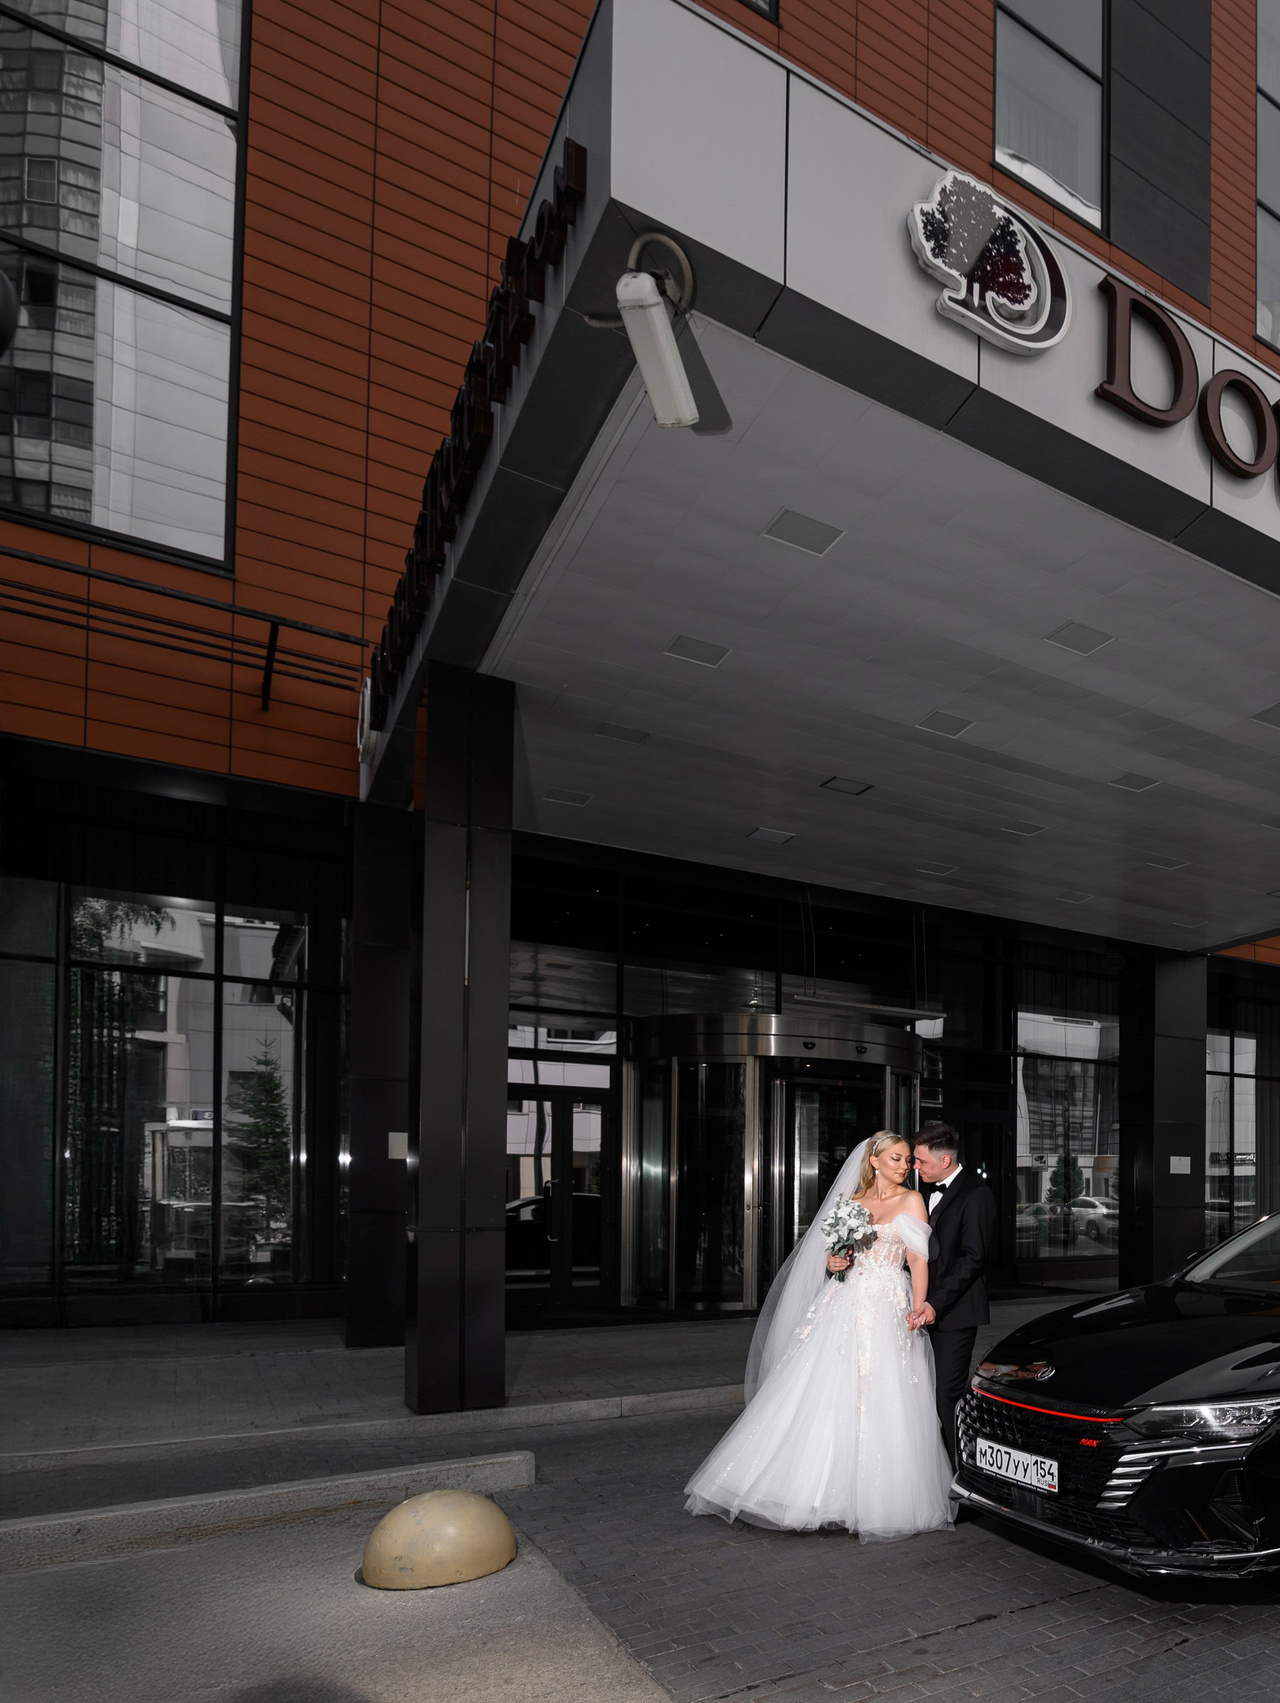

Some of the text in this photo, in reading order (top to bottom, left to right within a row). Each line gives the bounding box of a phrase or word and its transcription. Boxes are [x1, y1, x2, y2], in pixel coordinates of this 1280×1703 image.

[1079, 1438, 1099, 1447] MAX
[1033, 1459, 1055, 1481] 154
[1037, 1478, 1048, 1486] RUS
